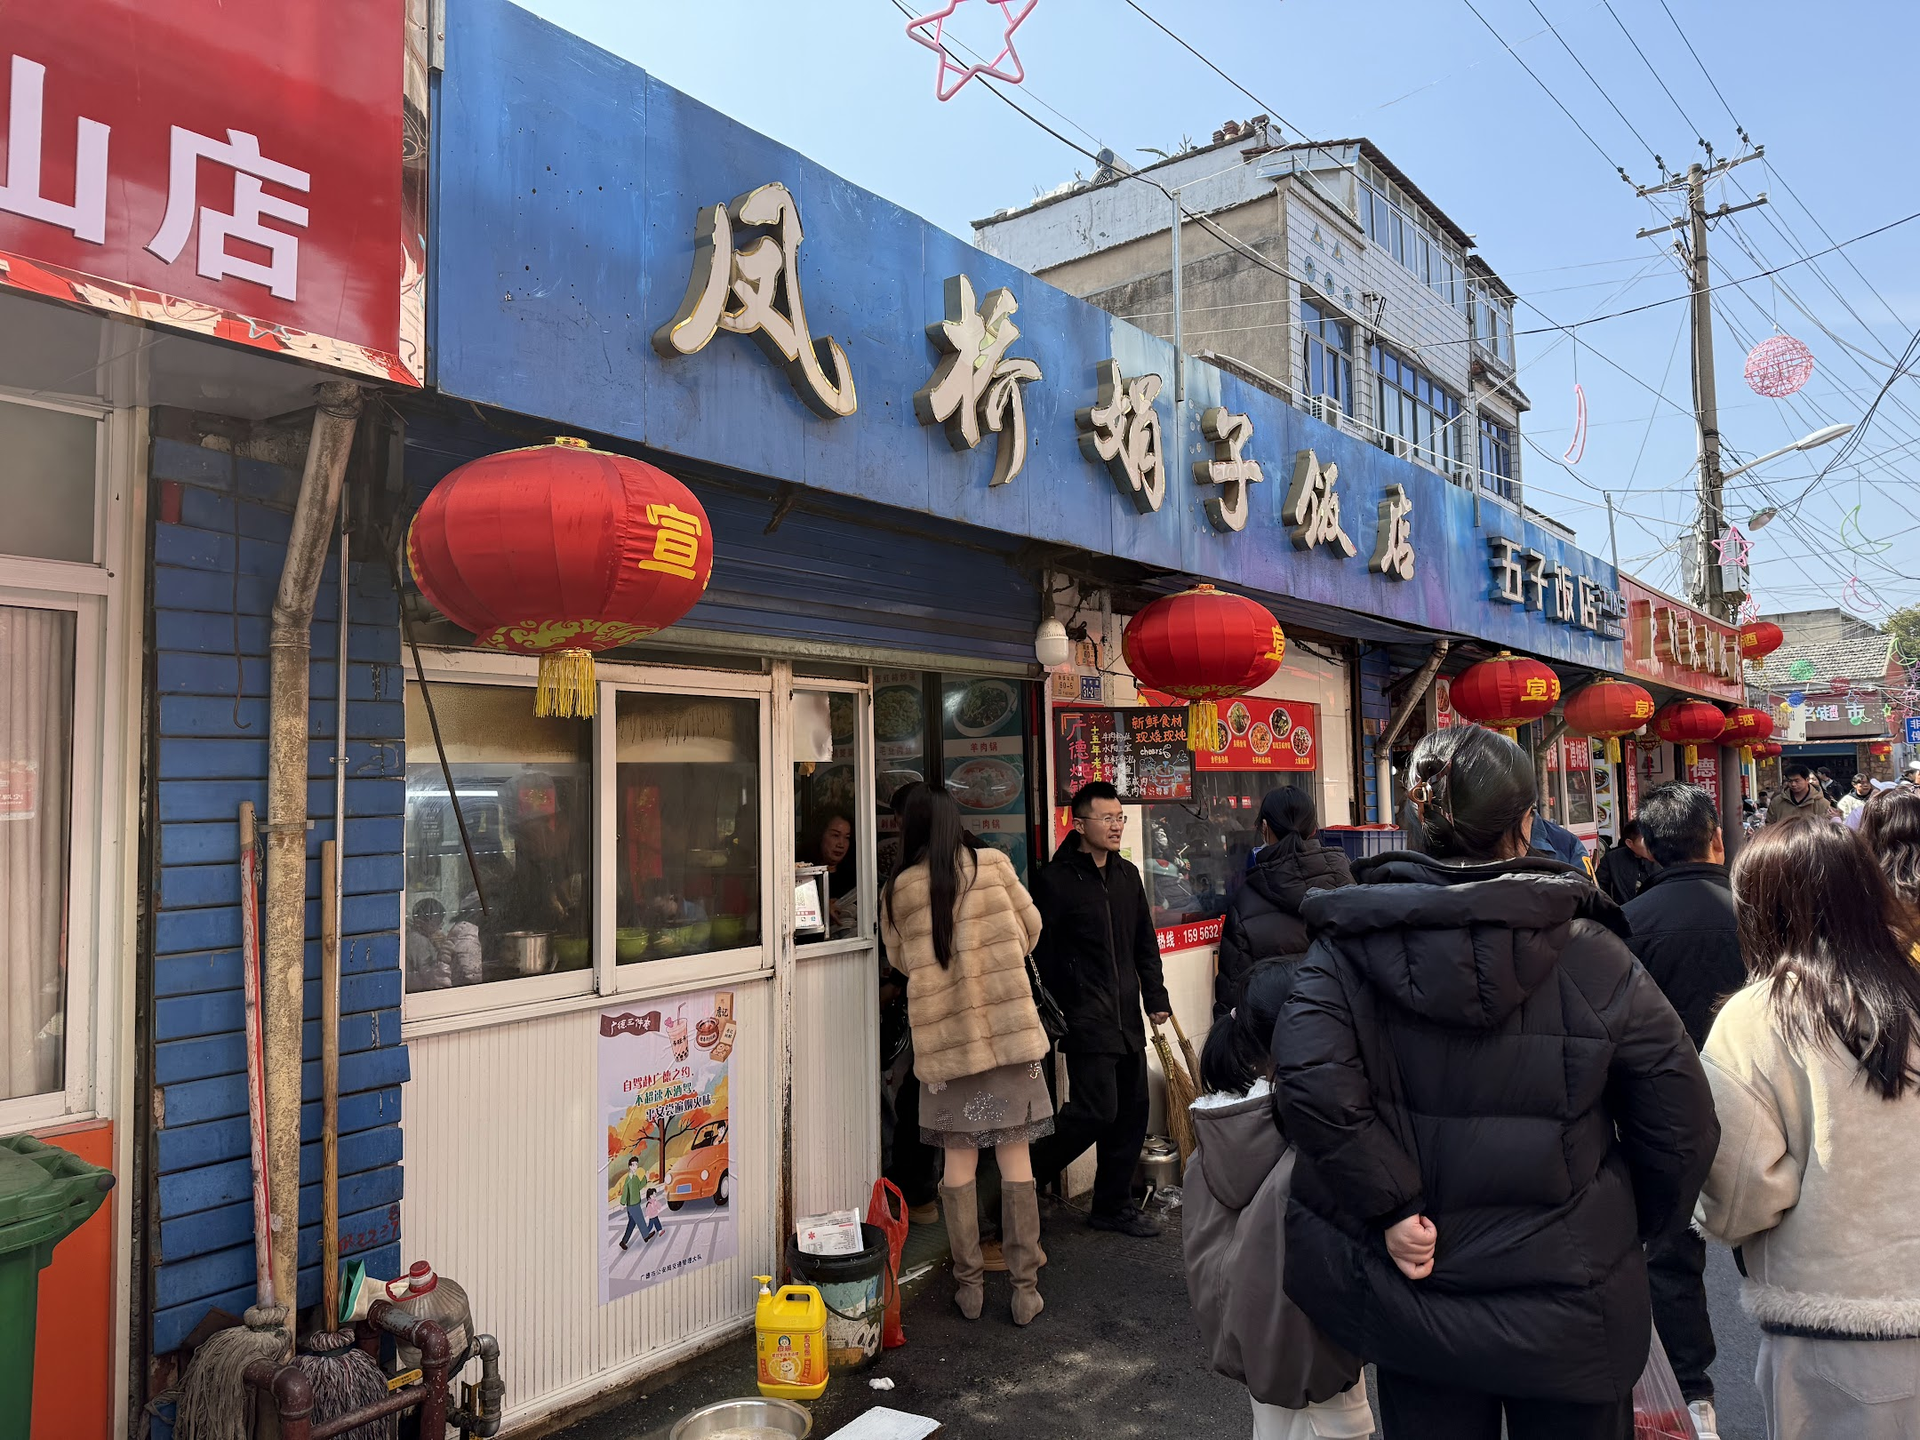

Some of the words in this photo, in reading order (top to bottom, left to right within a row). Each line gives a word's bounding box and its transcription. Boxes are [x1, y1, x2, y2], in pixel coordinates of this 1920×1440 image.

[1132, 714, 1183, 730] 新鲜食材
[1135, 728, 1188, 743] 现烧现炖
[970, 741, 998, 753] 羊肉锅
[1090, 726, 1103, 783] 十五年老店
[1183, 928, 1198, 944] 159
